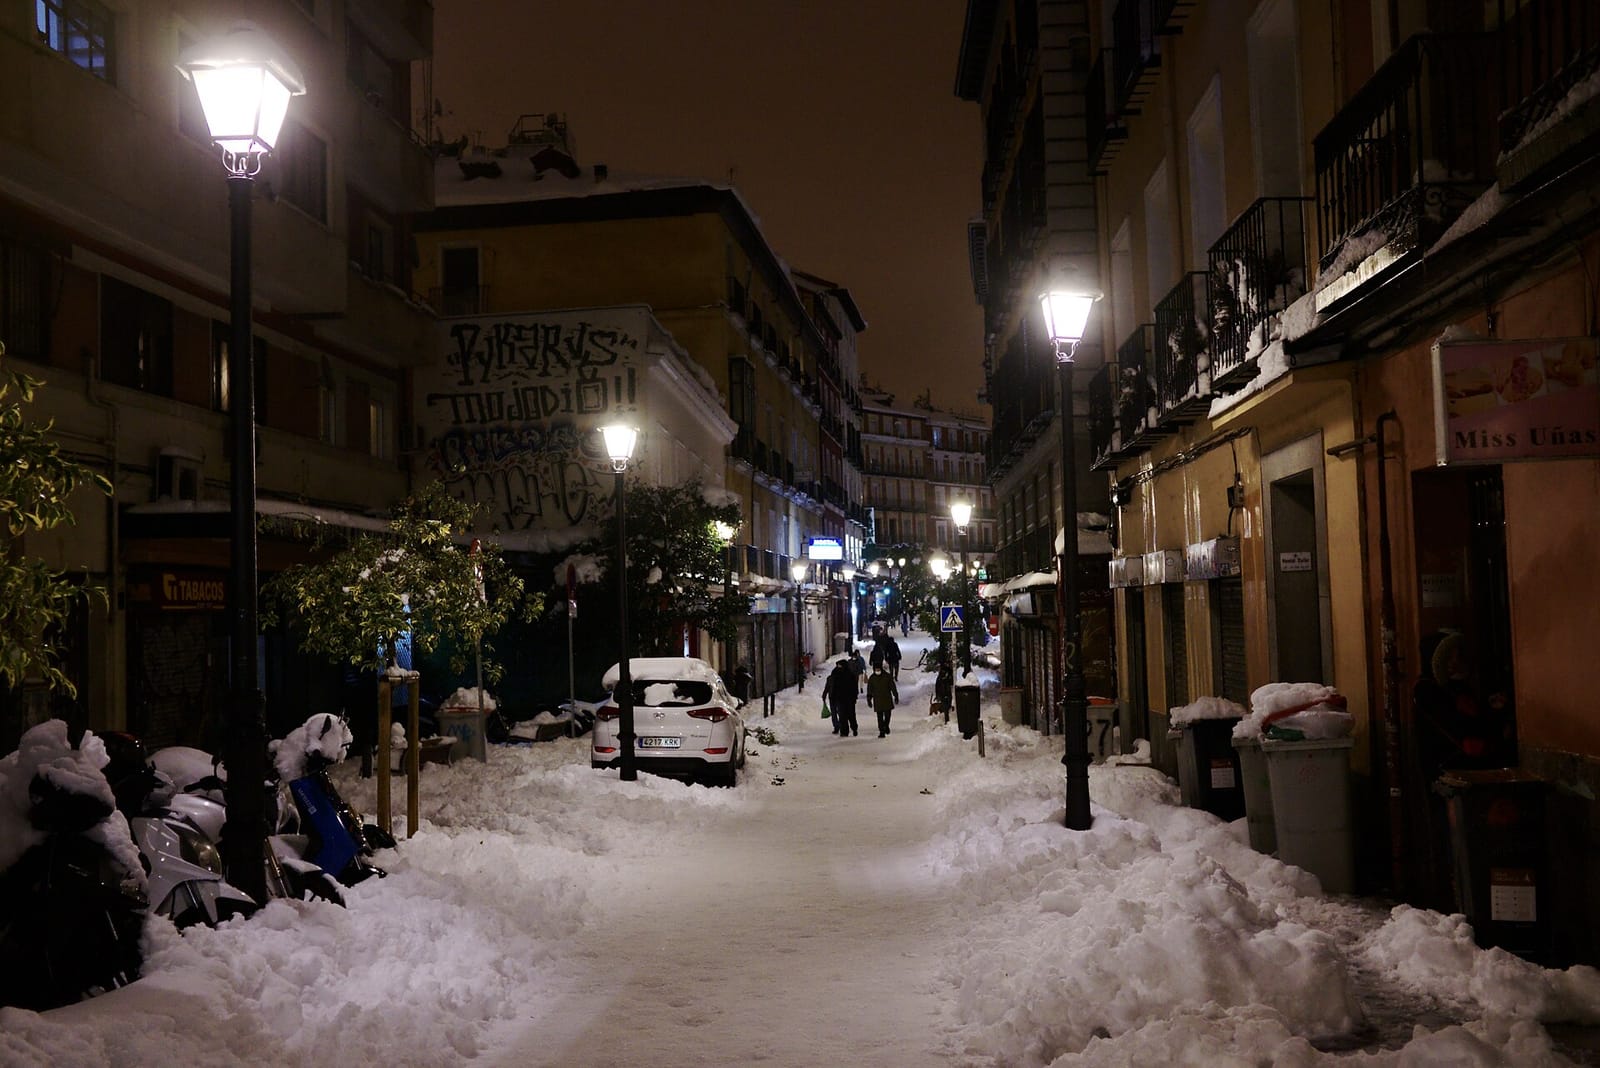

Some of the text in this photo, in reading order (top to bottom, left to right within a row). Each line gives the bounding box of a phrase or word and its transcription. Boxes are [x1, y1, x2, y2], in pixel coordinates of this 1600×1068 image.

[1456, 424, 1597, 449] Miss Uñas
[179, 579, 224, 600] TABACOS
[643, 738, 679, 746] 4217 KRK
